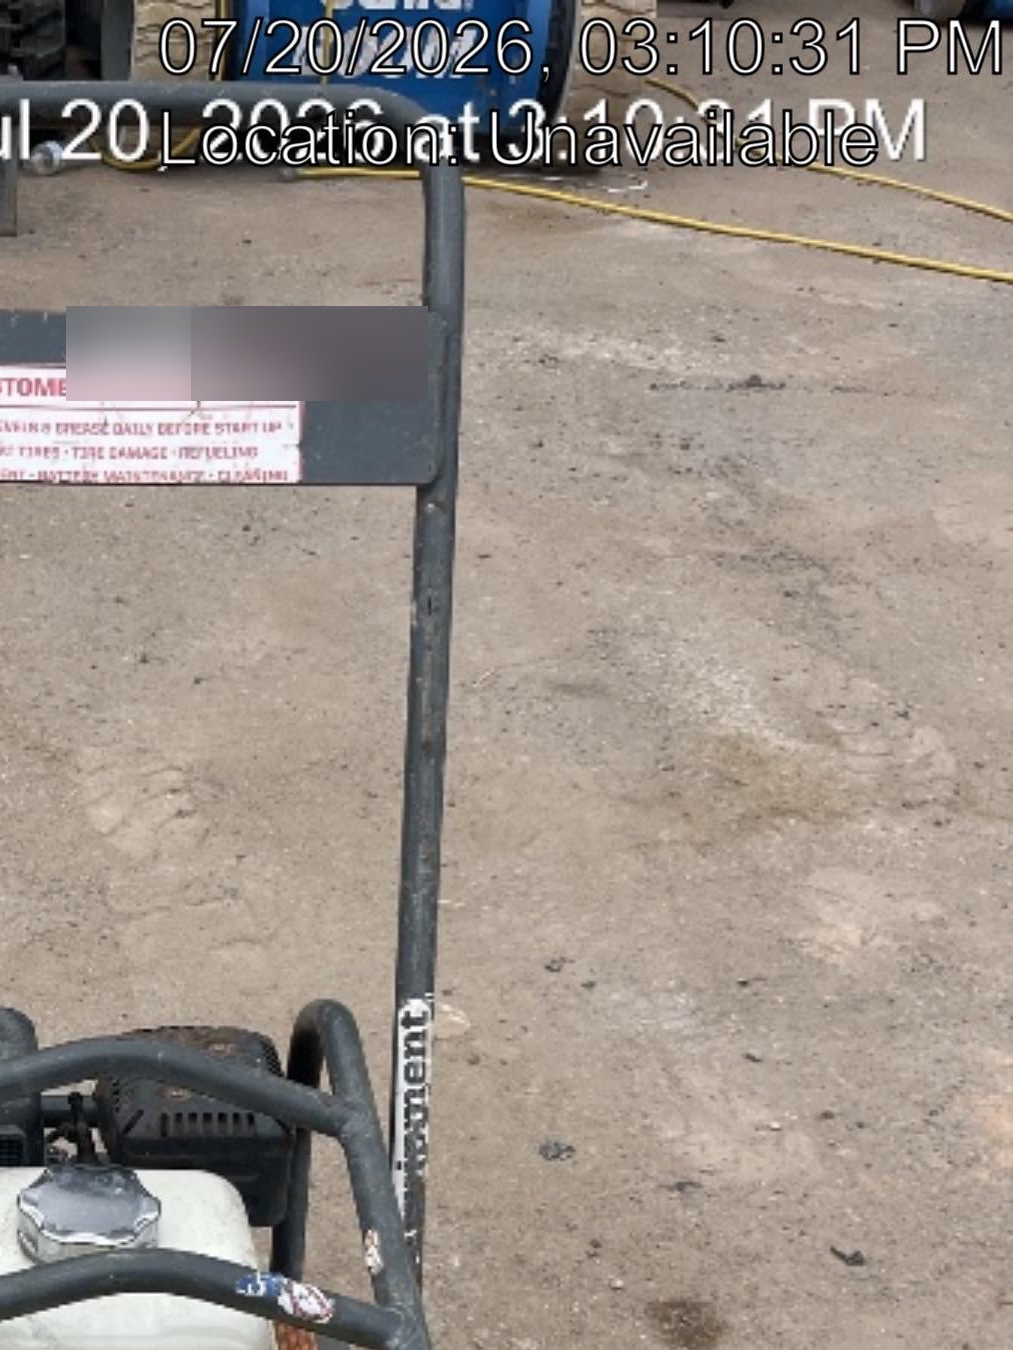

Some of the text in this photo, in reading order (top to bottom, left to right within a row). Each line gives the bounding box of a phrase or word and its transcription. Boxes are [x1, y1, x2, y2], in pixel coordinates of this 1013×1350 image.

[55, 421, 109, 437] GREASE
[112, 421, 154, 436] DAILY
[158, 421, 211, 436] BEFORE
[215, 420, 259, 435] START
[262, 420, 283, 434] UP
[72, 446, 106, 461] TIRE
[109, 446, 168, 460] DAMAGE
[178, 446, 259, 461] REFUELING
